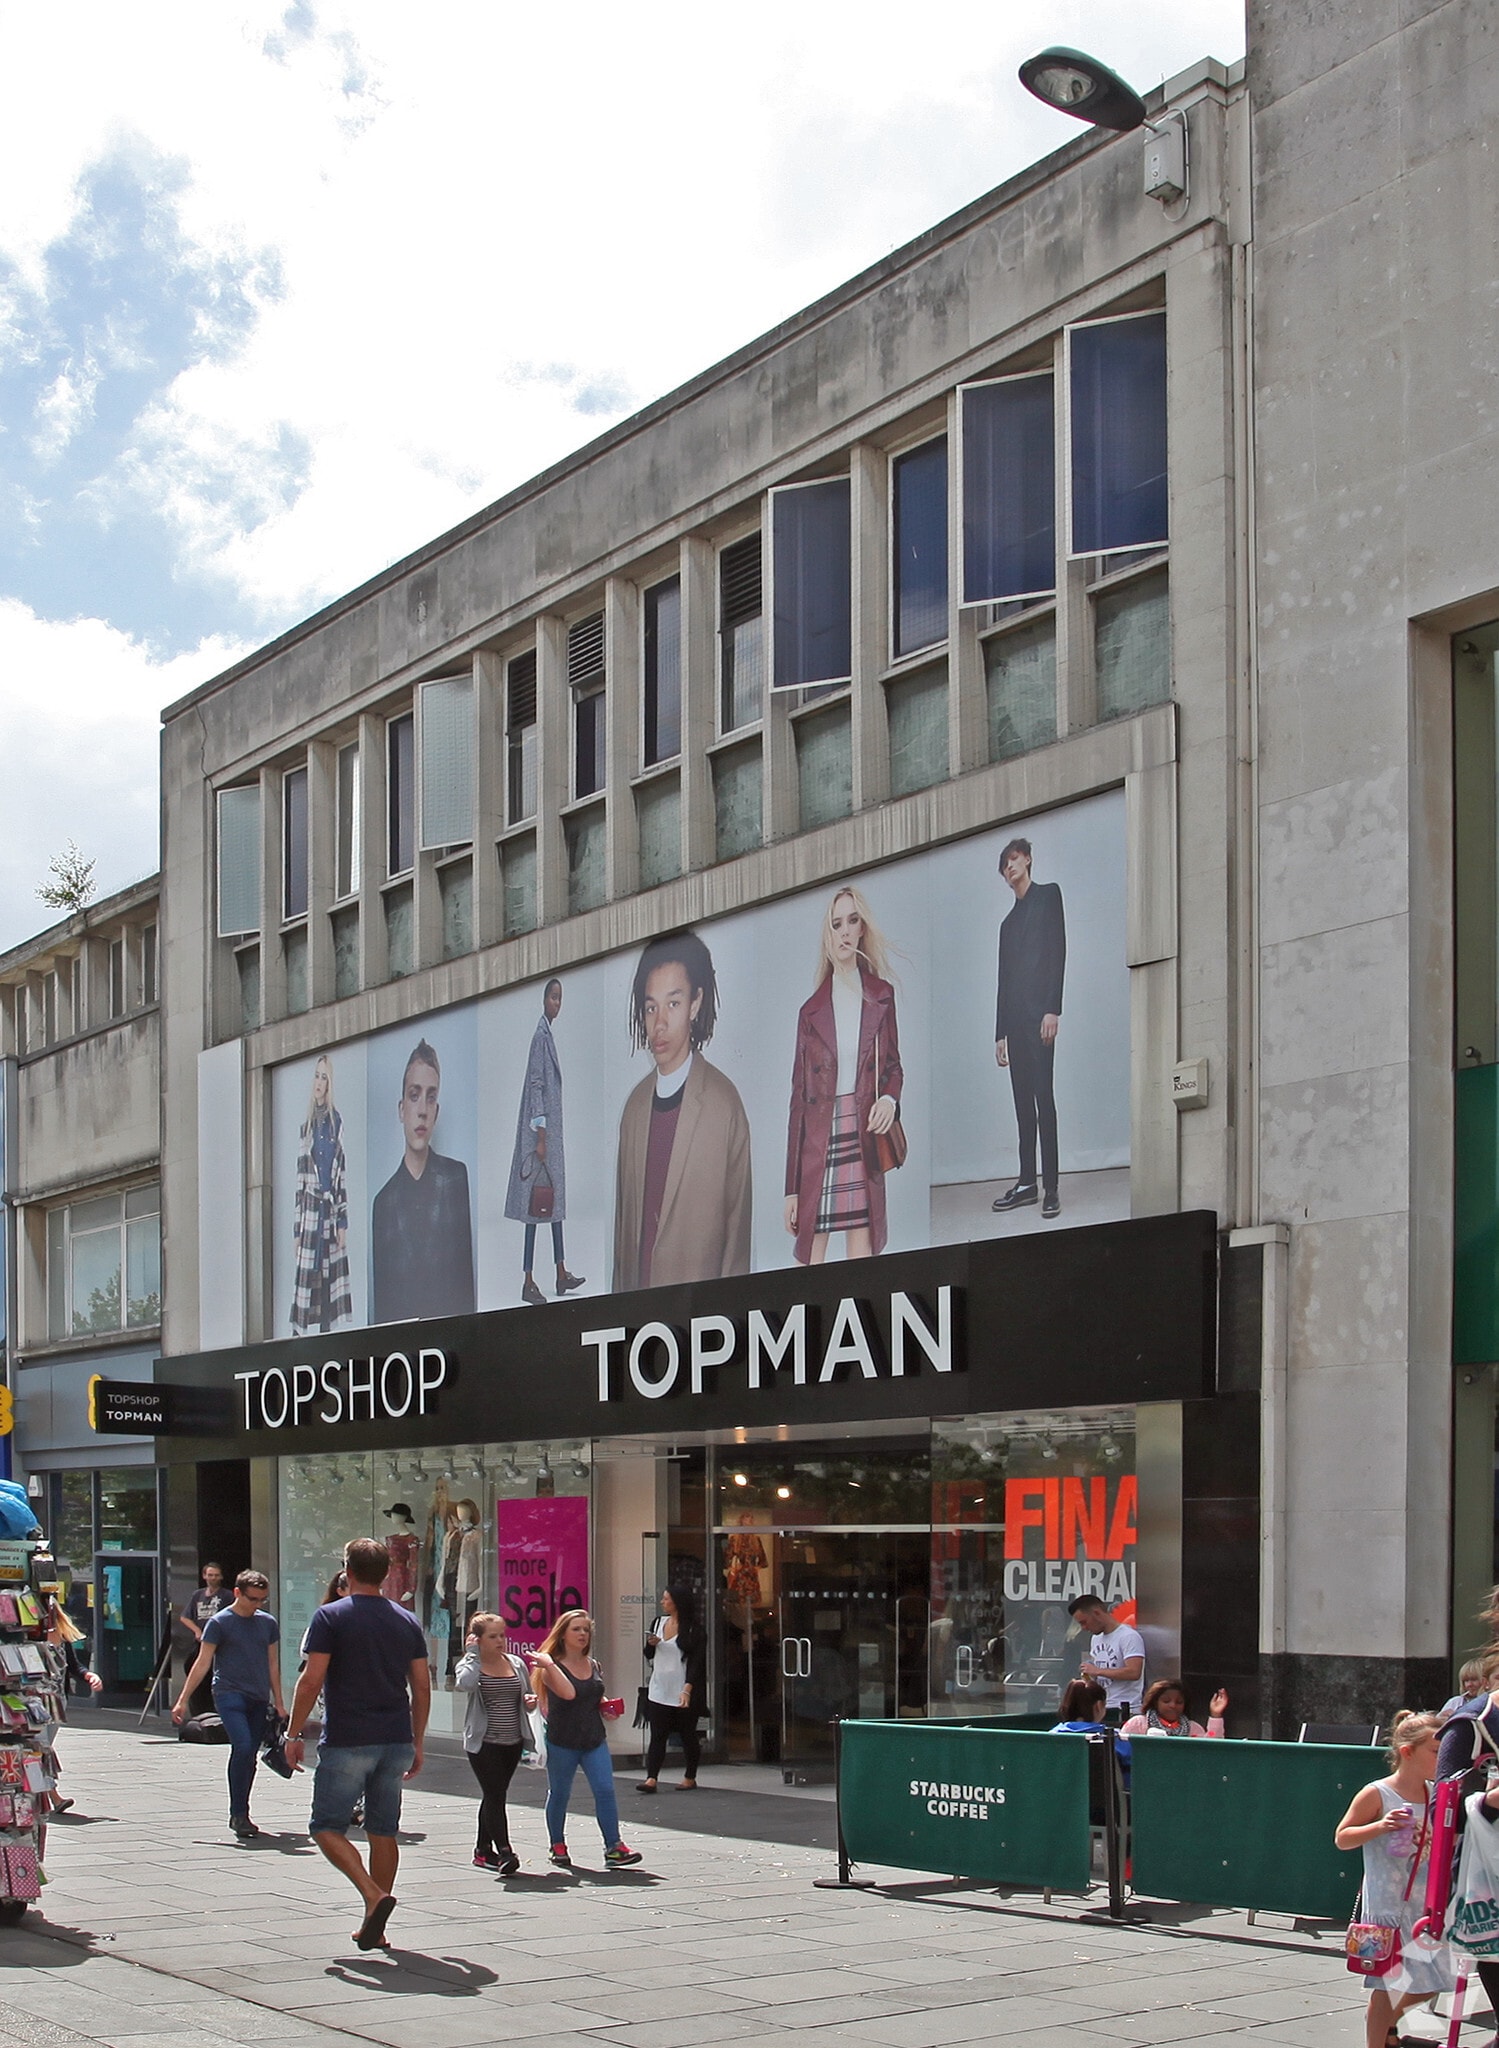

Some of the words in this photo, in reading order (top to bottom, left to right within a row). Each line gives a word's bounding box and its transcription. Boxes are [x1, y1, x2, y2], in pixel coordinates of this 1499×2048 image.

[580, 1284, 953, 1402] TOPMAN
[107, 1394, 160, 1405] TOPSHOP
[234, 1348, 446, 1430] TOPSHOP
[106, 1410, 163, 1422] TOPMAN
[504, 1558, 547, 1576] more
[504, 1572, 583, 1629] sale
[504, 1637, 536, 1655] lines
[910, 1780, 1006, 1804] STARBUCKS
[927, 1799, 989, 1820] COFFEE
